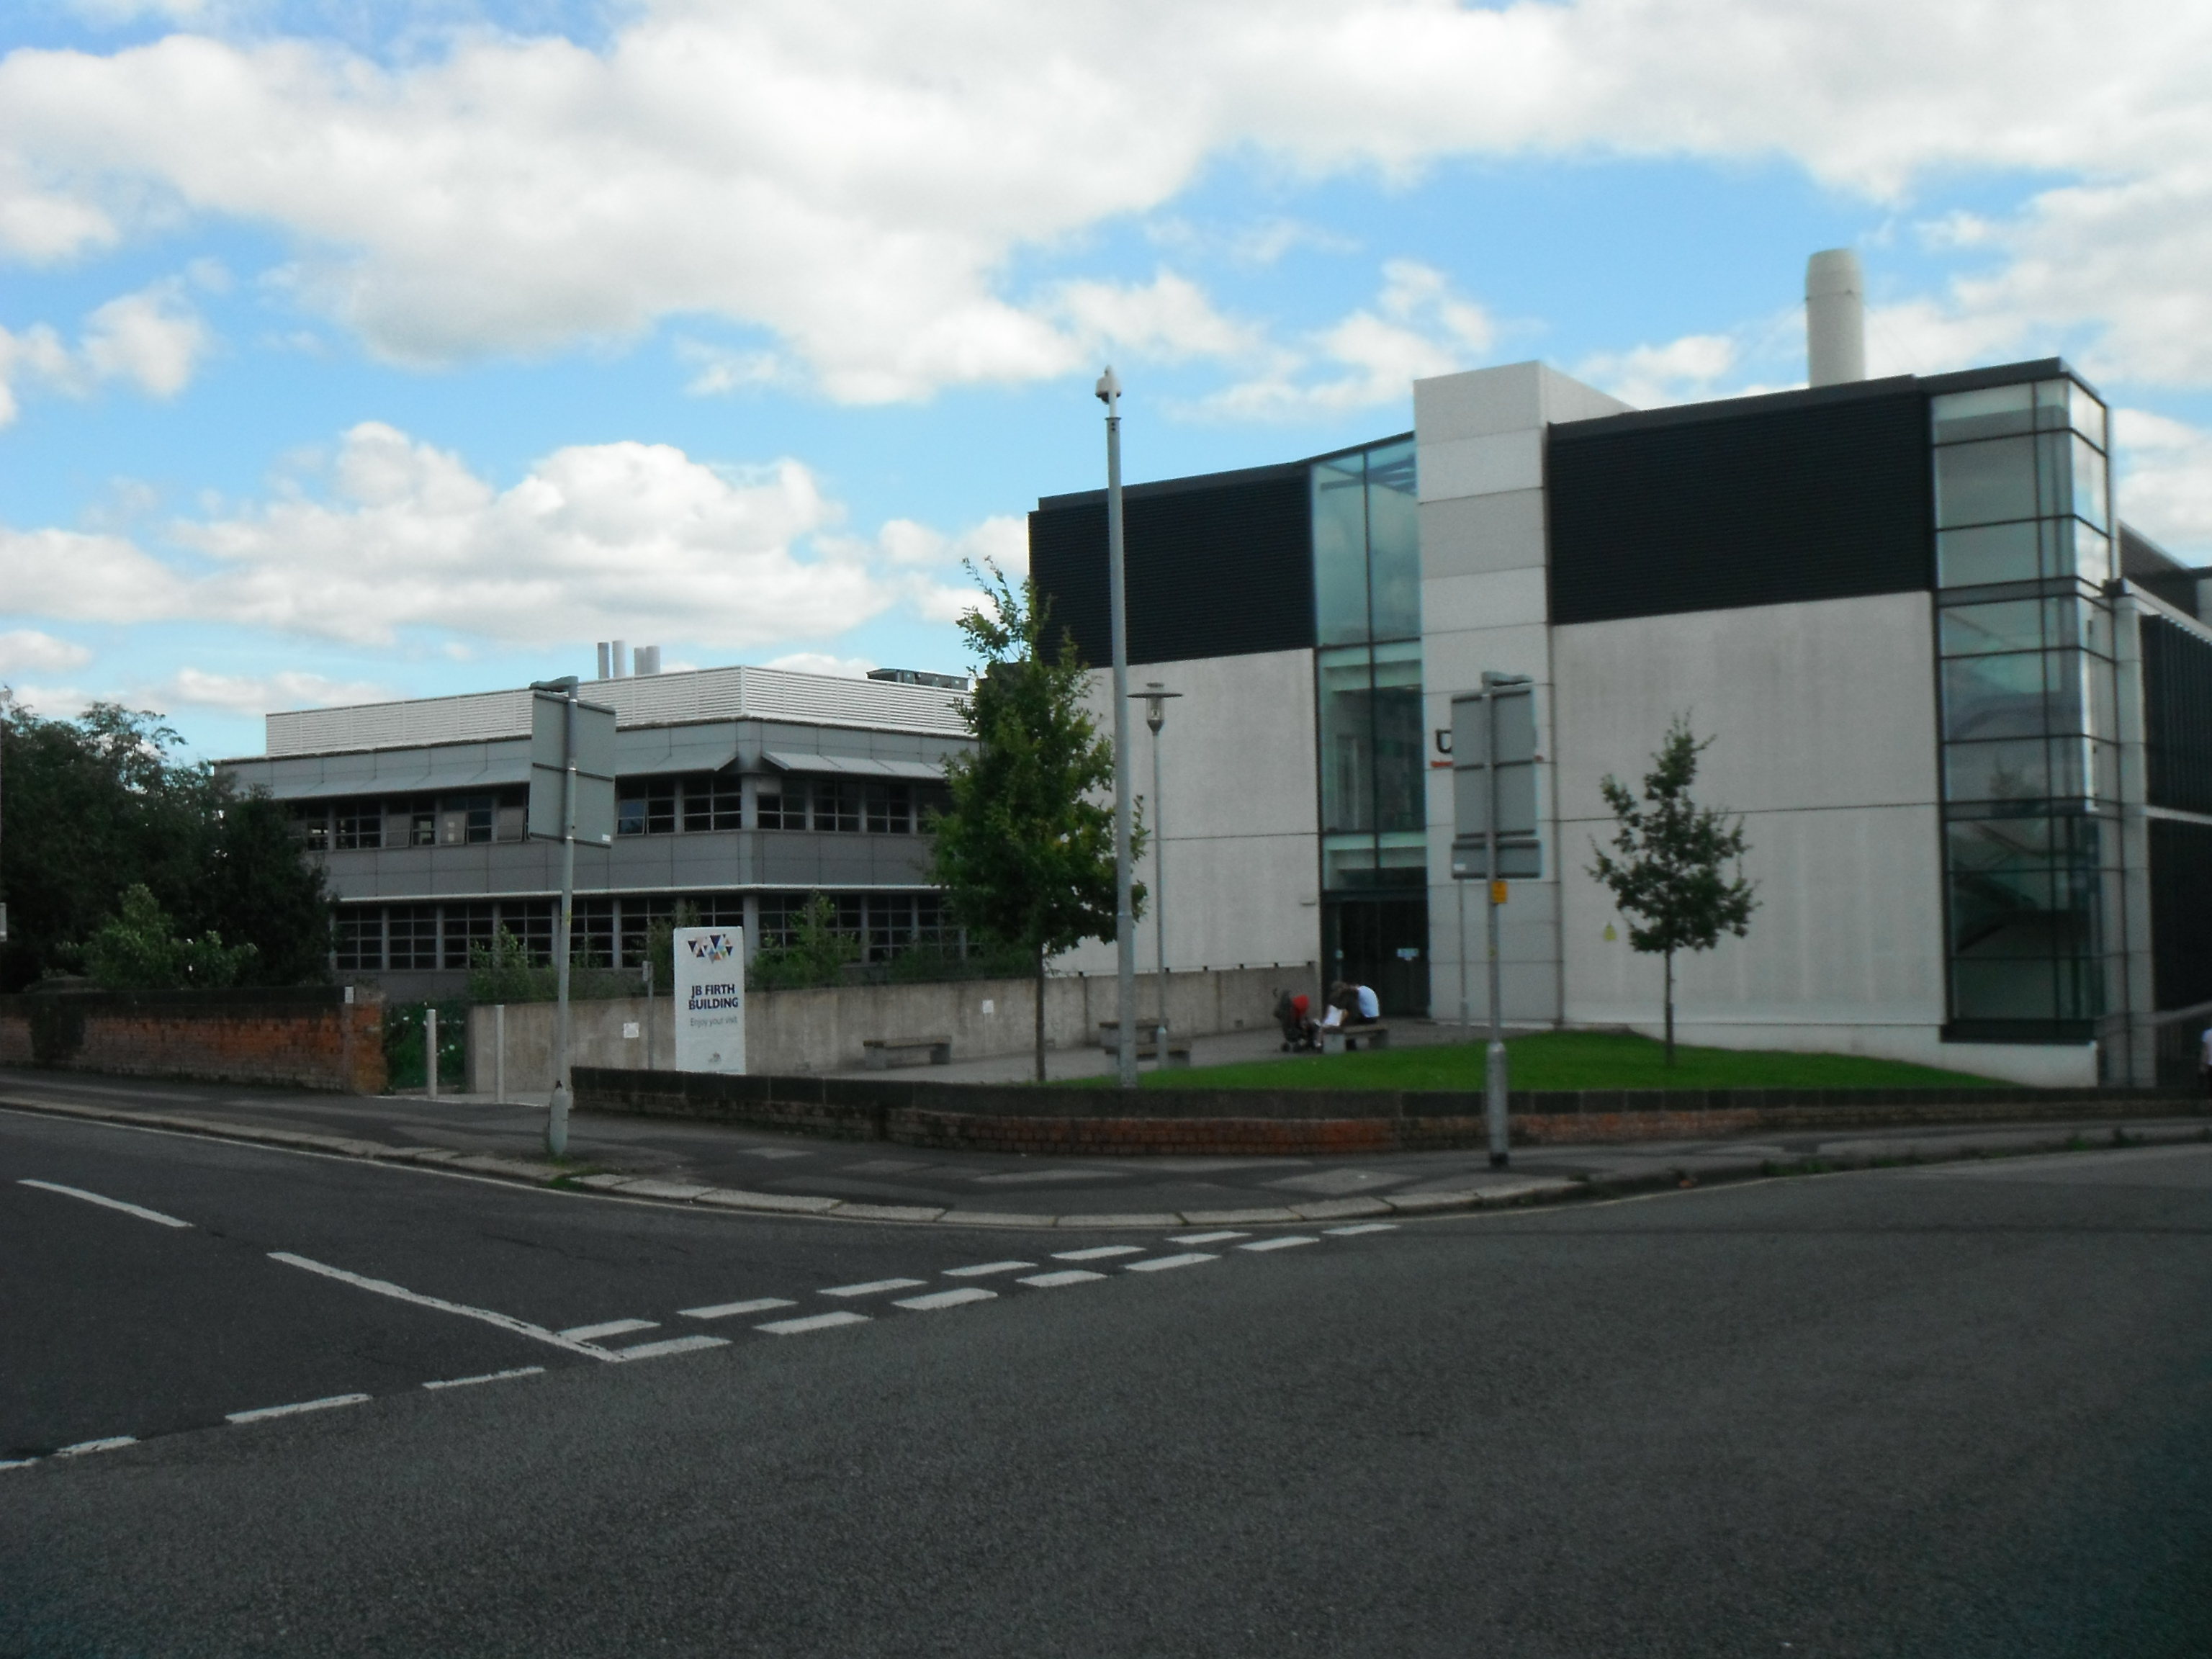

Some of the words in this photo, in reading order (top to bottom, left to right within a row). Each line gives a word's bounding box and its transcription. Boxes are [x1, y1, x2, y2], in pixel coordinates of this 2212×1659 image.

[691, 986, 702, 999] JB
[705, 984, 735, 995] FIRTH
[688, 997, 739, 1010] BUILDING
